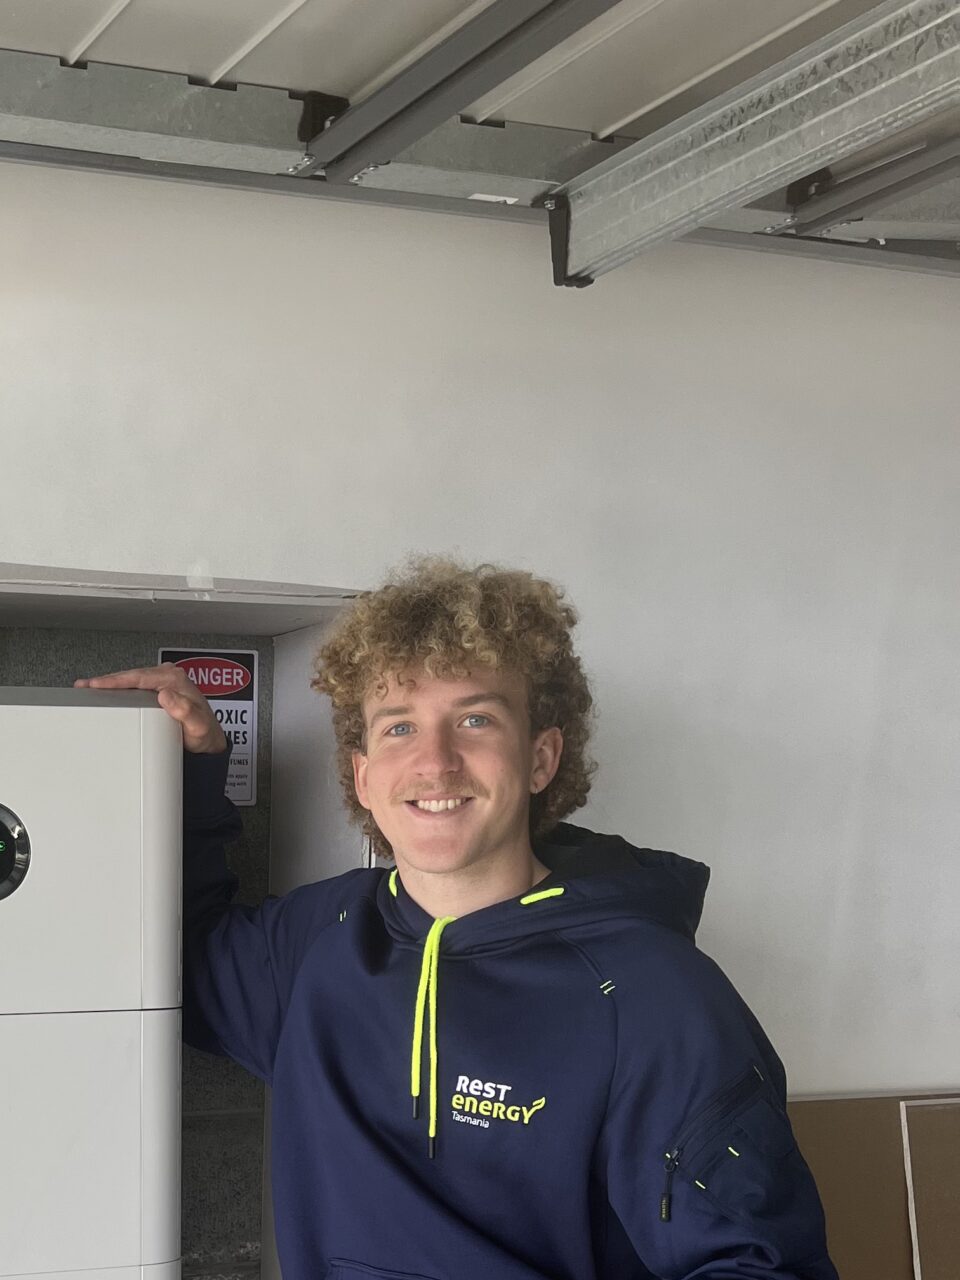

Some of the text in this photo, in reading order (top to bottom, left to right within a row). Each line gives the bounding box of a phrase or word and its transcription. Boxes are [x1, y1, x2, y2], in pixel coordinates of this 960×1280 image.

[187, 667, 244, 686] ANGER
[215, 709, 248, 725] OXIC
[451, 1110, 490, 1129] Tasmania
